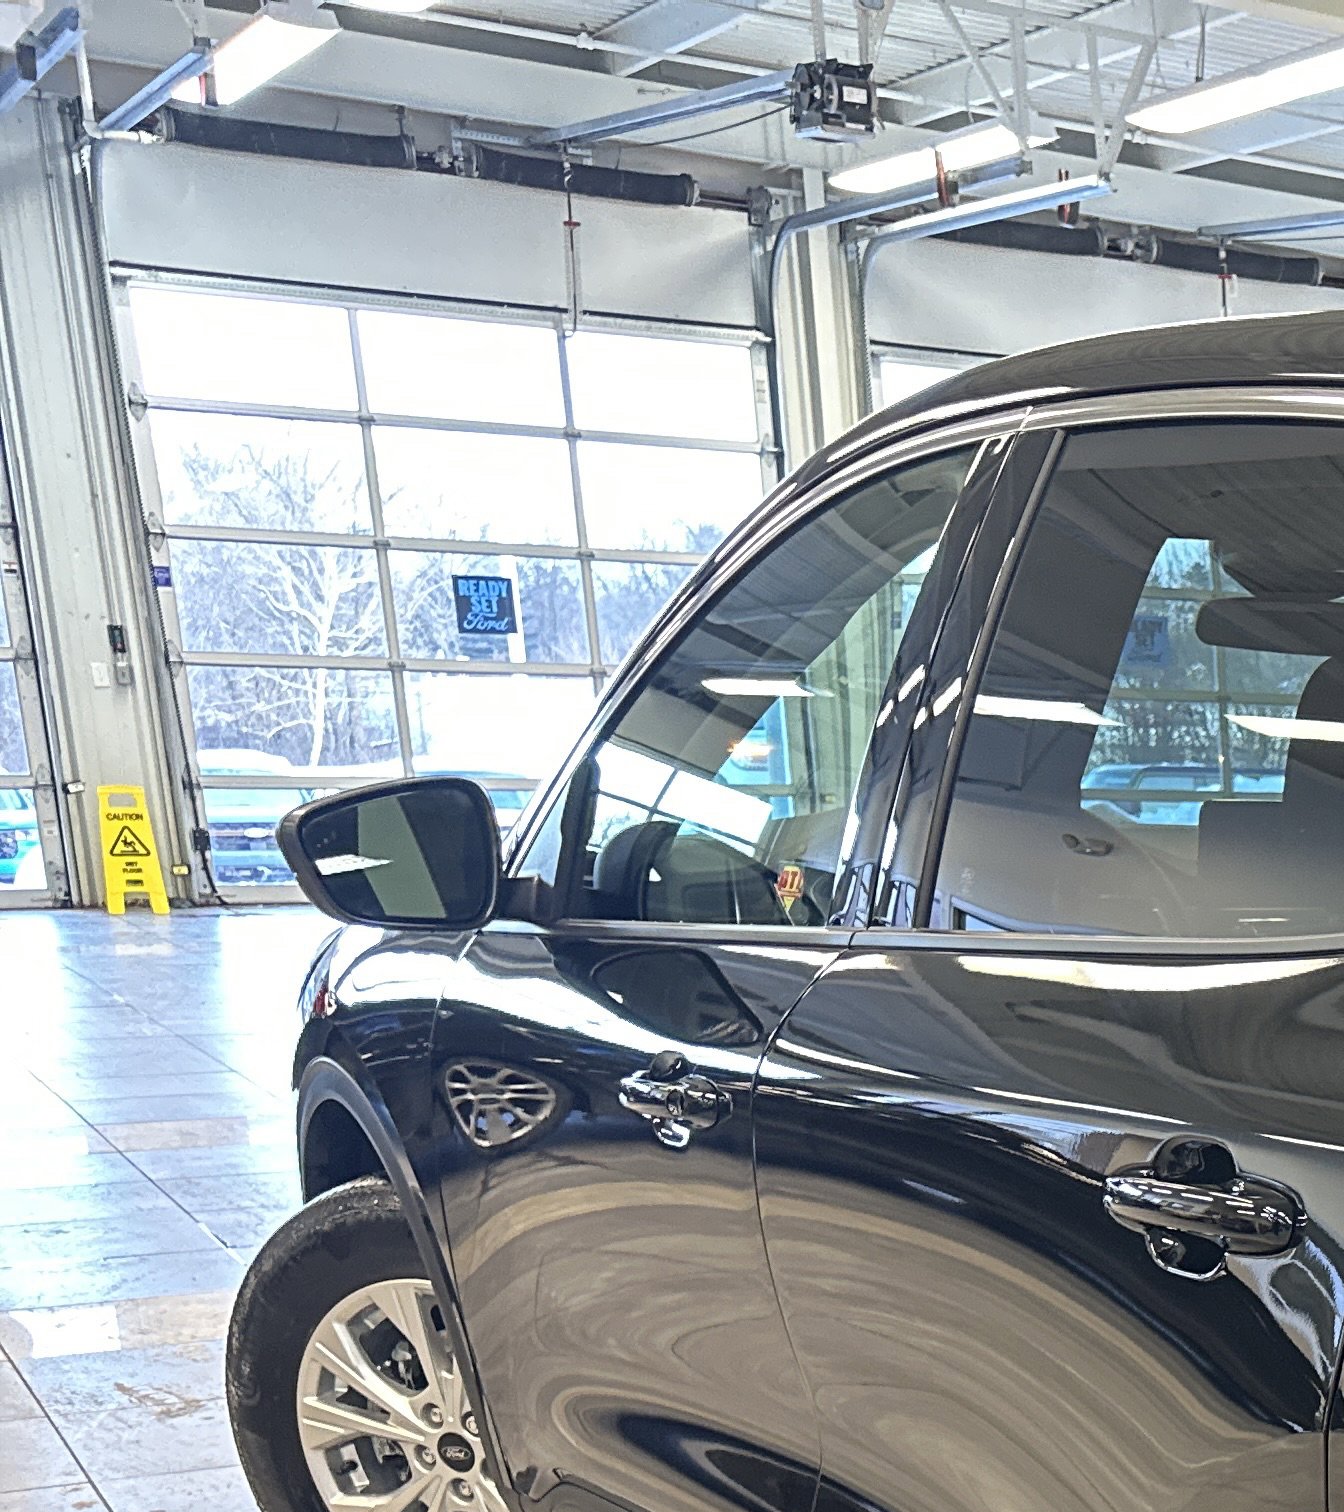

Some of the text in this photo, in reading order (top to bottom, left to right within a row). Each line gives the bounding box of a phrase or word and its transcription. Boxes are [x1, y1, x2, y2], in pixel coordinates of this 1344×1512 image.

[458, 579, 508, 597] READY
[470, 596, 499, 613] SET
[463, 612, 509, 631] Ford
[106, 812, 144, 821] CAUTION
